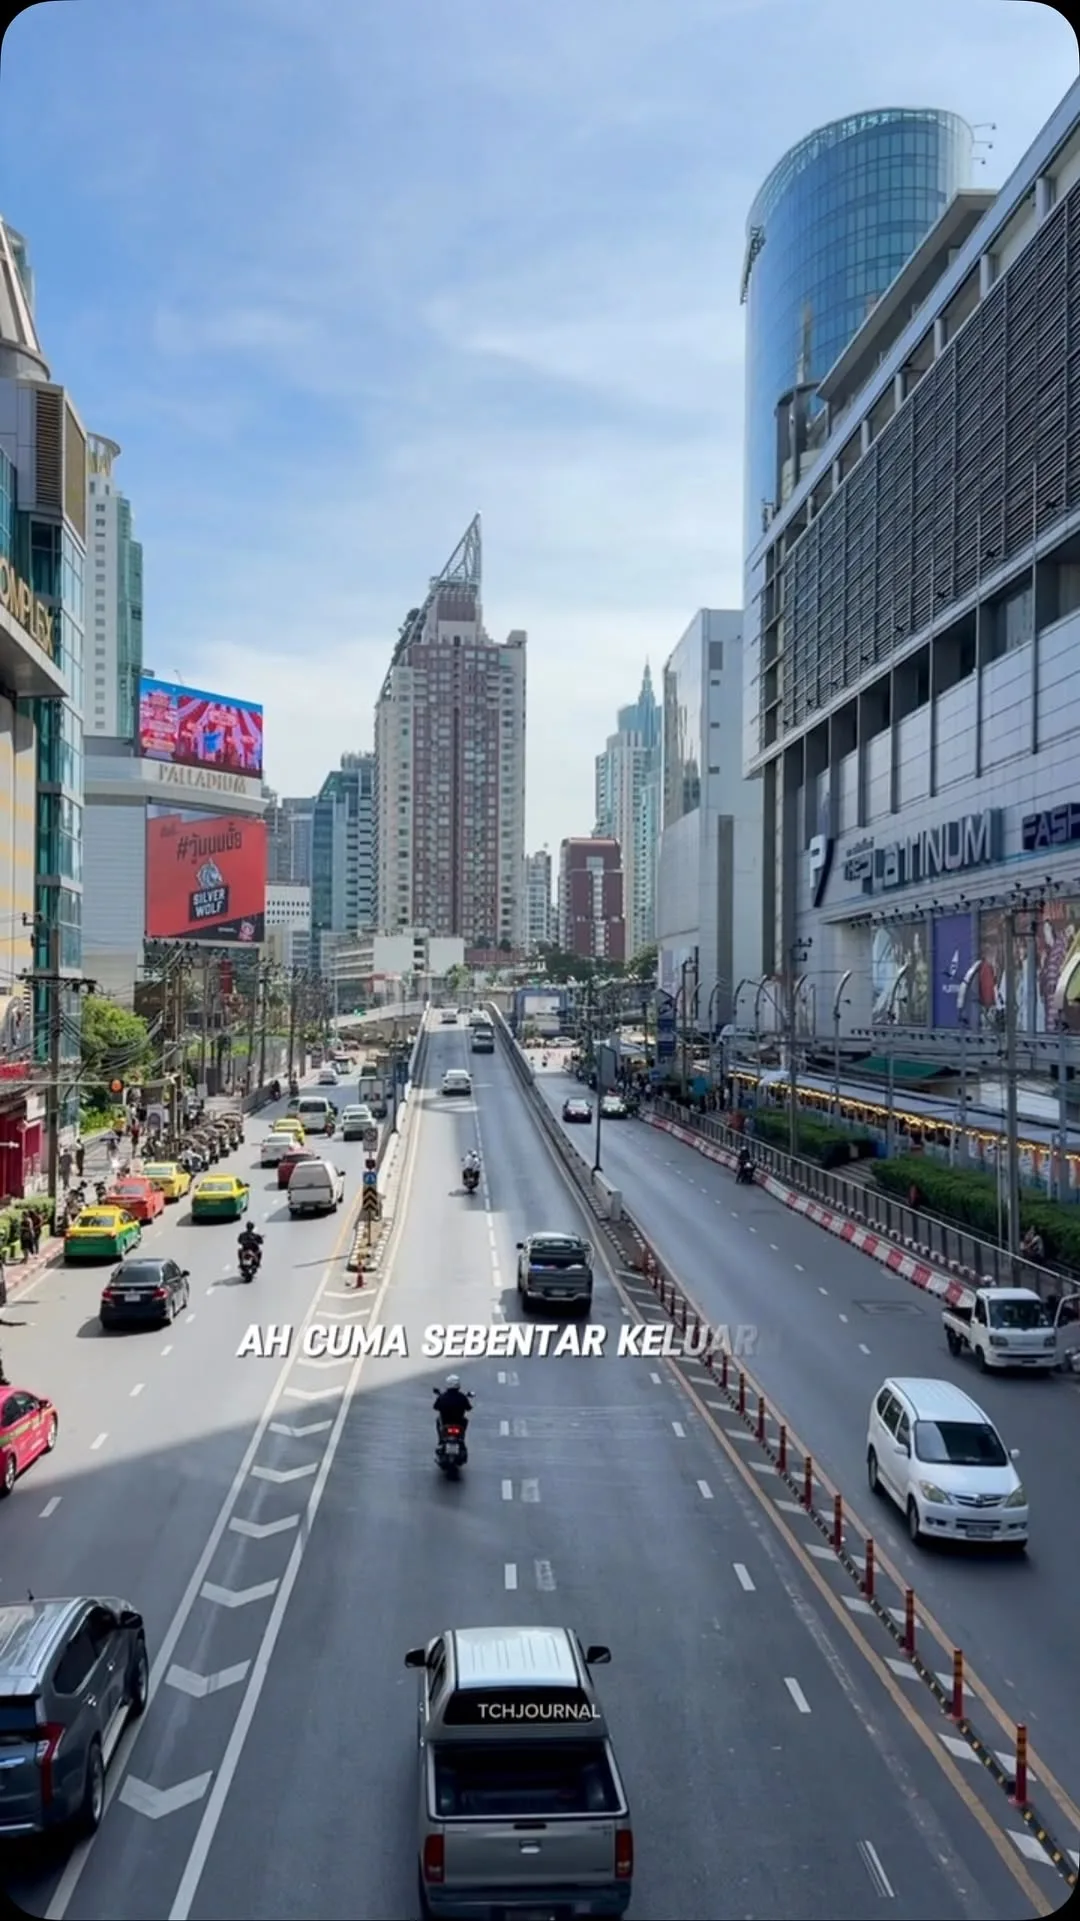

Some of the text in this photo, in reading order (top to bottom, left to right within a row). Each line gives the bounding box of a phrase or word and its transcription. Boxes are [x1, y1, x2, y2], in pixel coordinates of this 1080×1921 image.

[159, 764, 247, 795] PALLADIUM
[192, 887, 226, 906] SILVER
[195, 900, 223, 918] WOLF
